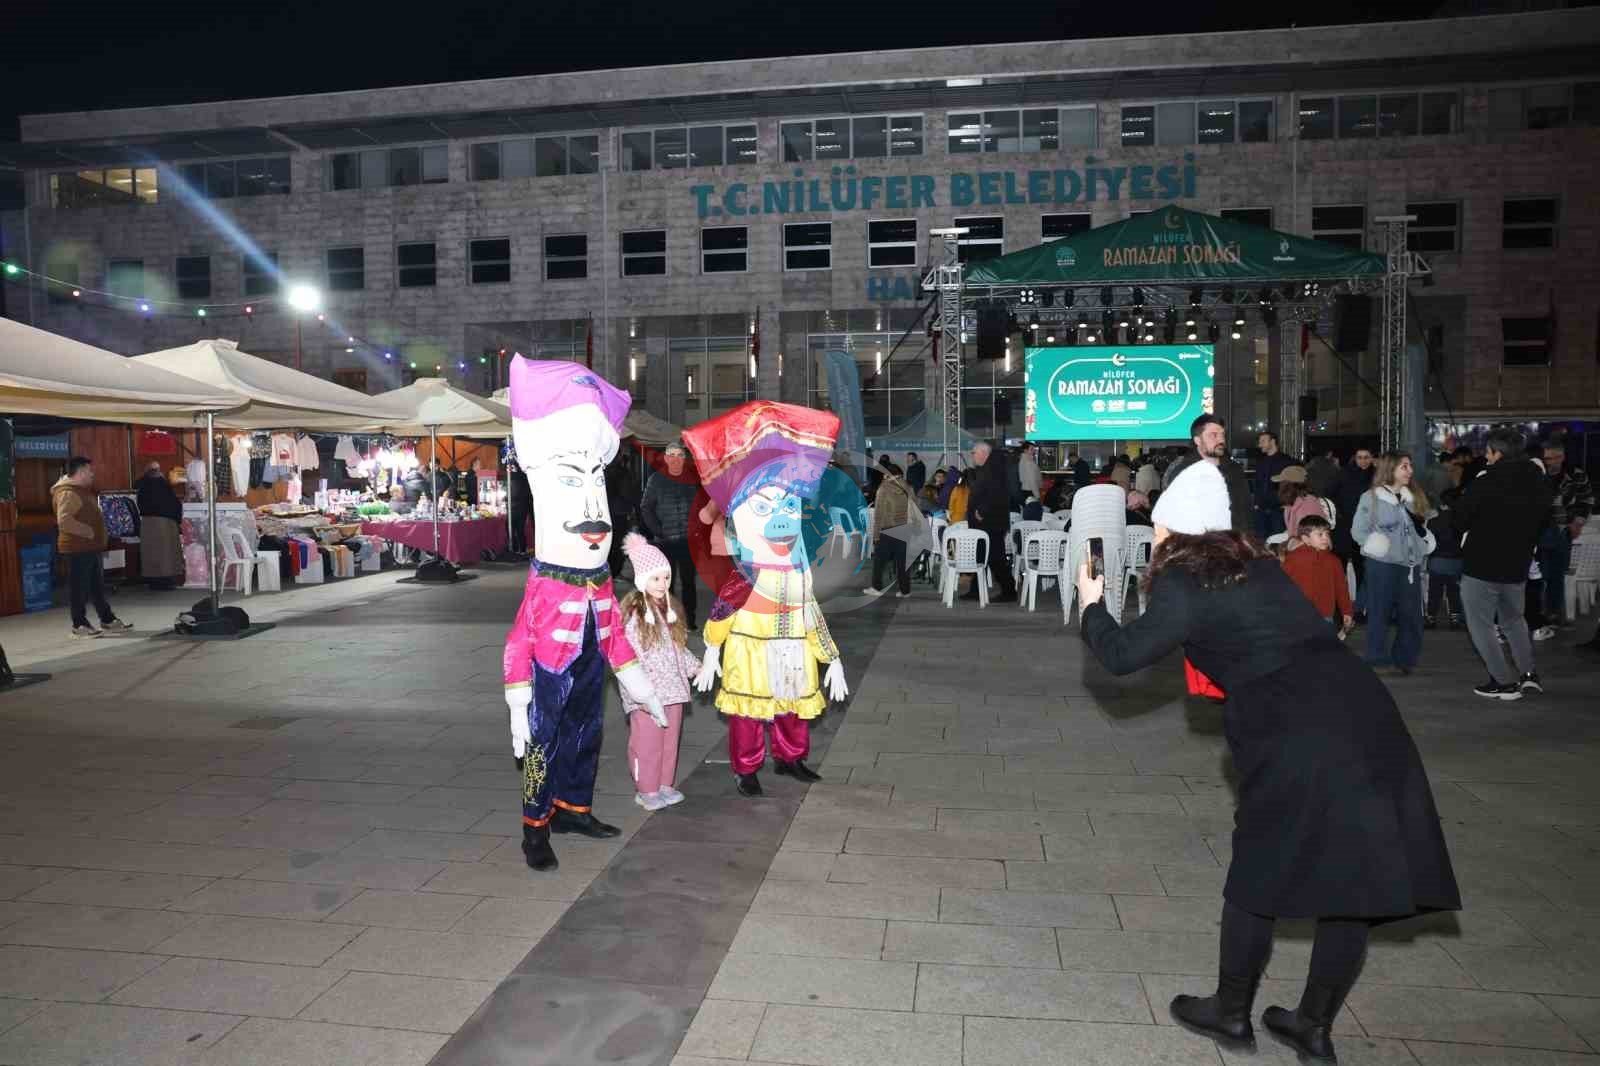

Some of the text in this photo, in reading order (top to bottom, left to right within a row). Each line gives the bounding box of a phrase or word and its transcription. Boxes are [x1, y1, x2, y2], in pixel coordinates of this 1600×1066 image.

[951, 152, 1196, 207] BELEDİYESİ
[1104, 241, 1241, 267] RAMAZAN SOKAĞI
[1058, 376, 1180, 396] RAMAZAN SOKAĞI
